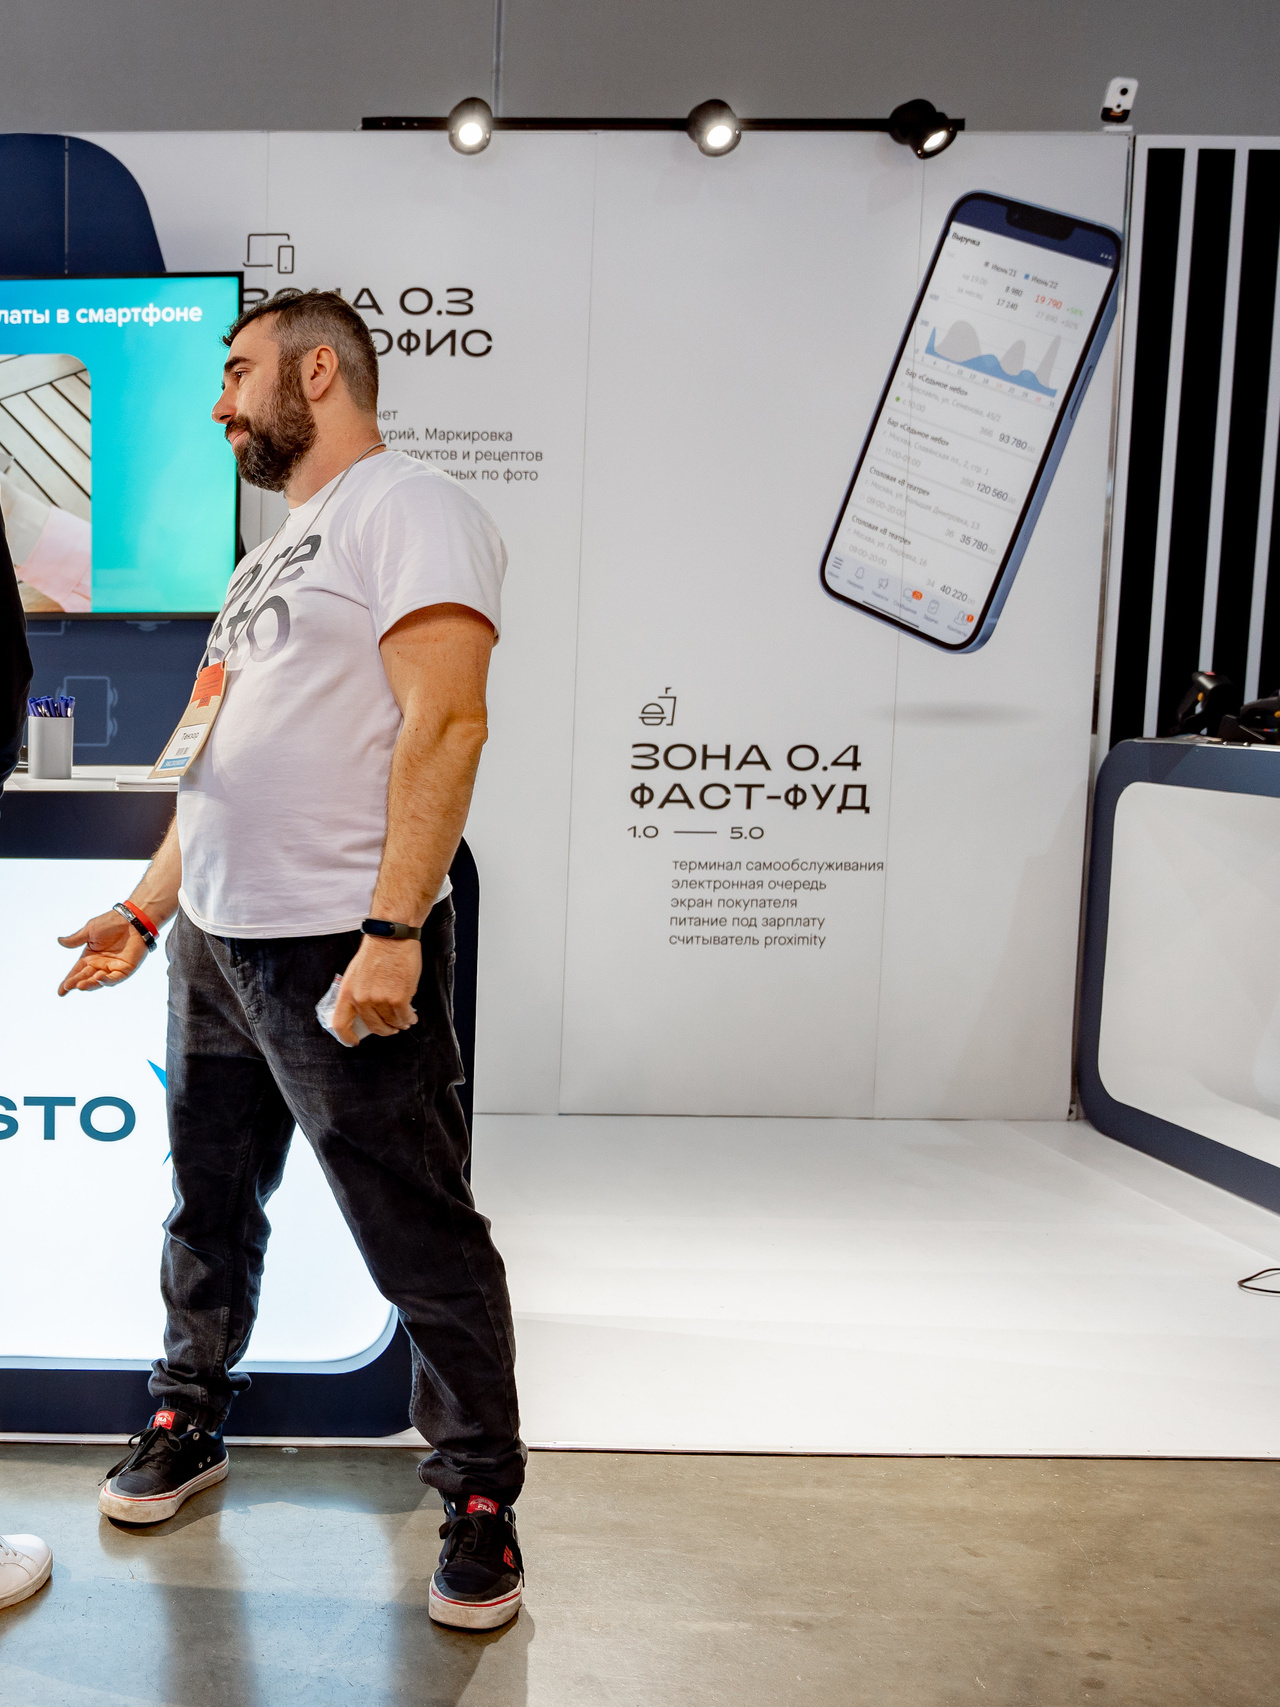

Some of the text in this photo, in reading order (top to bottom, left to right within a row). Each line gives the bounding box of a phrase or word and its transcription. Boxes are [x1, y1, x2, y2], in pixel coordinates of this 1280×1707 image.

[243, 286, 385, 316] ЗА
[56, 308, 70, 324] в
[75, 302, 203, 328] смартфоне
[424, 427, 513, 444] Маркировка
[397, 449, 543, 464] одуктов и рецептов
[481, 470, 499, 480] по
[503, 468, 538, 483] фото
[630, 742, 861, 771] ЗОНА 0.4
[630, 782, 870, 814] ФАСТ-ФУД
[627, 825, 765, 840] 1.0 5.0
[672, 858, 884, 874] терминал самообслуживания
[671, 878, 827, 893] электронная очередь
[670, 898, 798, 912] экран покупателя
[669, 916, 825, 930] питание под зарплату
[668, 933, 826, 948] считыватель proximity
